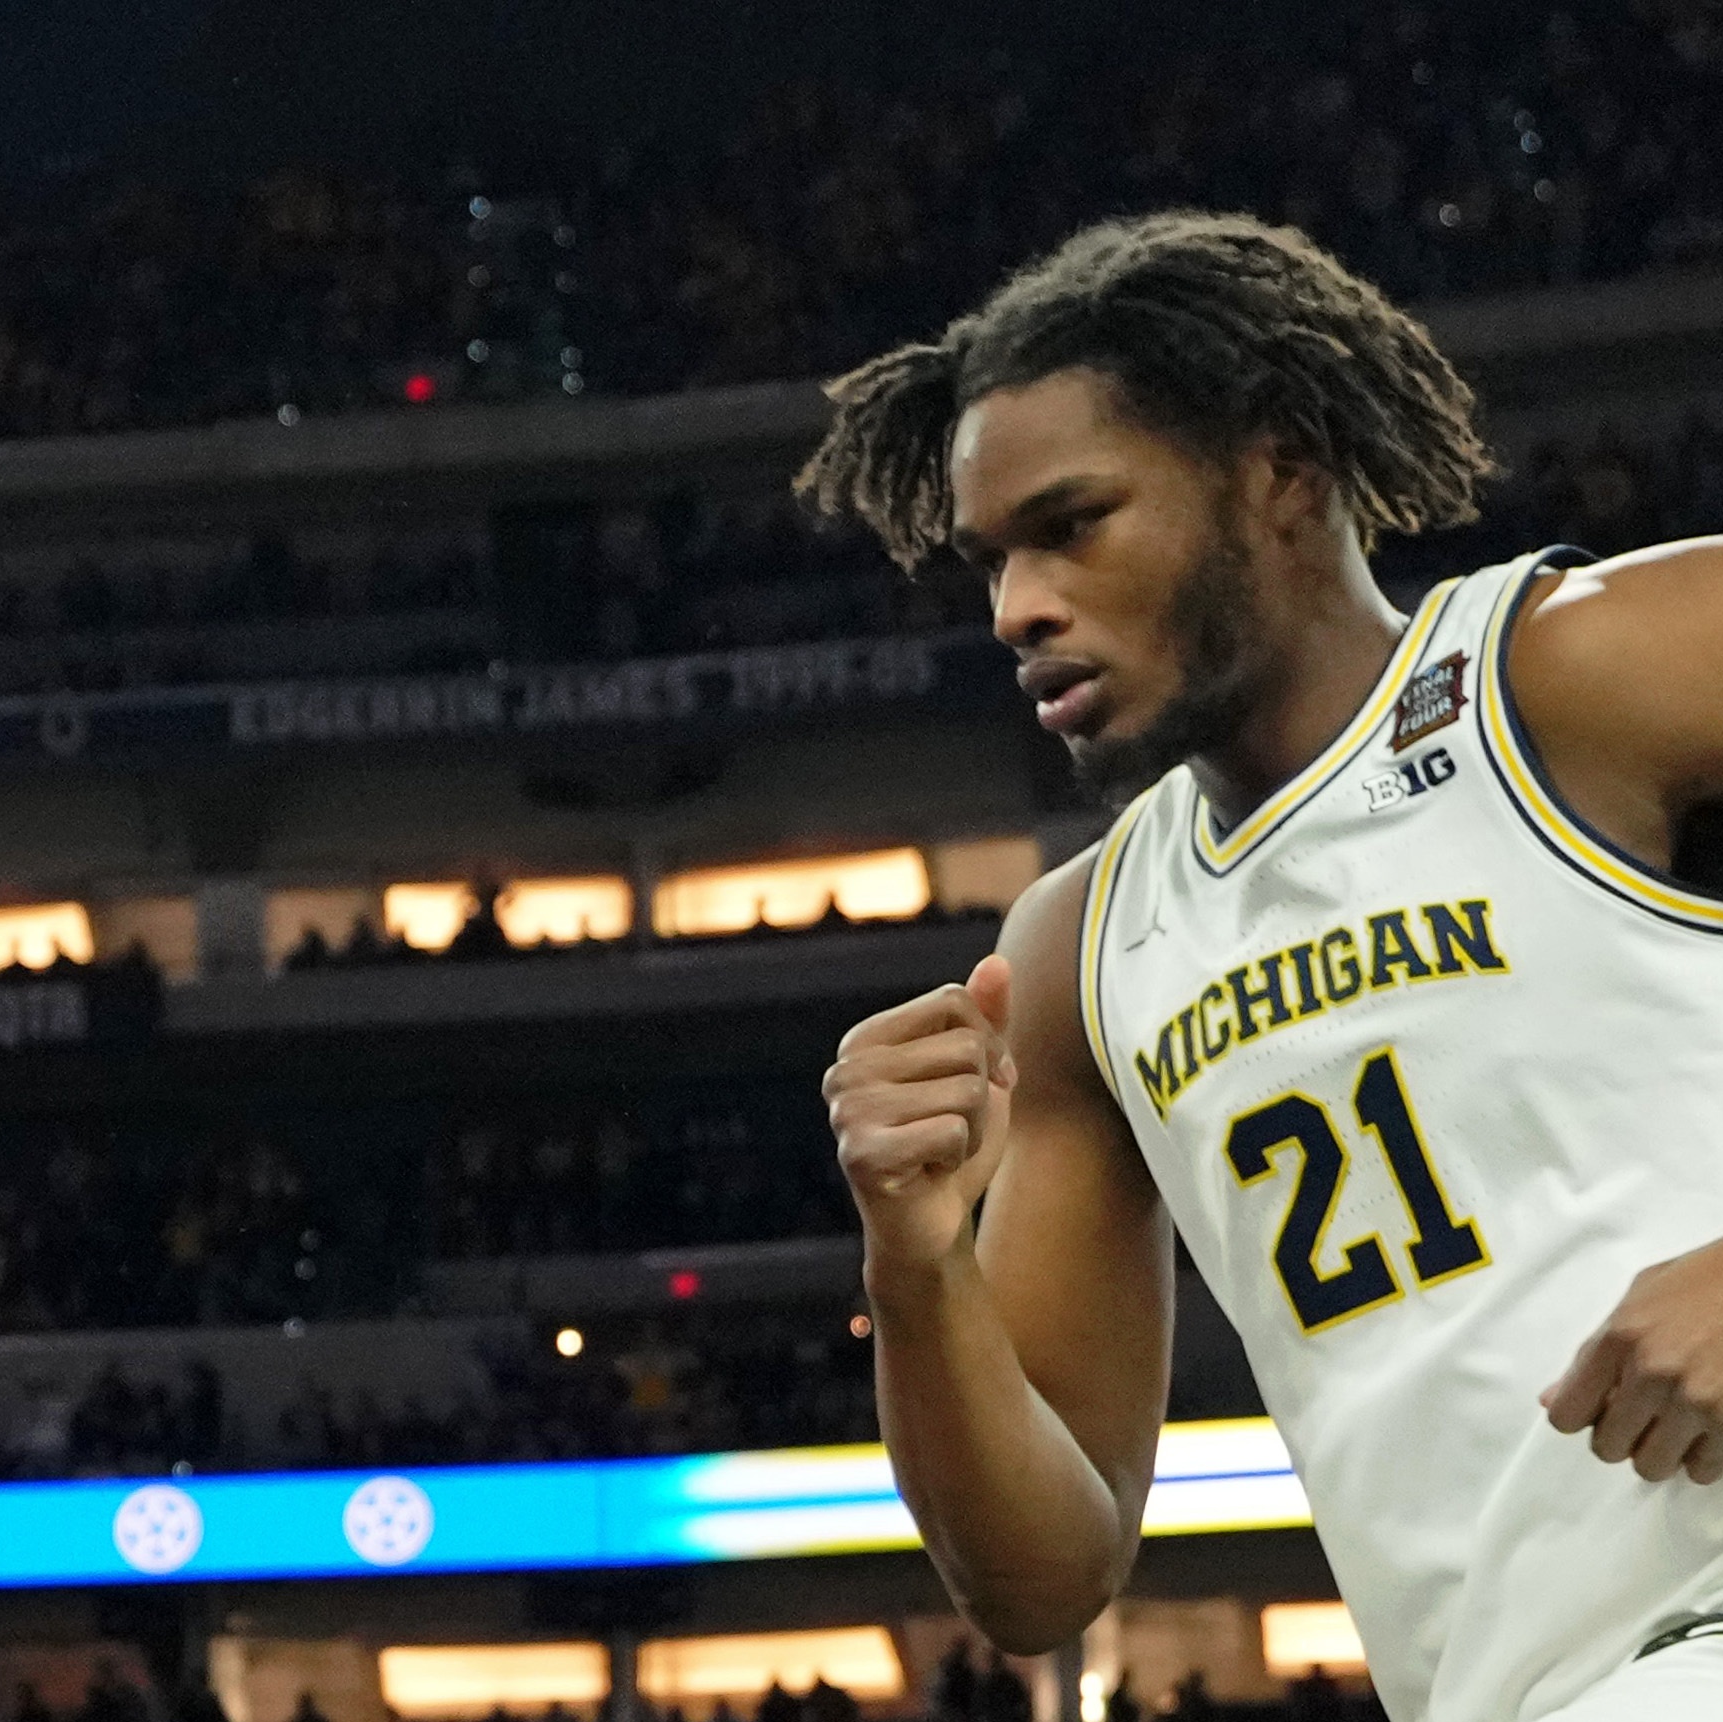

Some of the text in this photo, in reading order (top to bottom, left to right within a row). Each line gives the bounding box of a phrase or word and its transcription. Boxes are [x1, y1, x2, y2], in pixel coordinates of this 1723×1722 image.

[517, 663, 696, 725] JAMES
[1133, 898, 1511, 1124] MICHIGAN
[1222, 1045, 1493, 1337] 21
